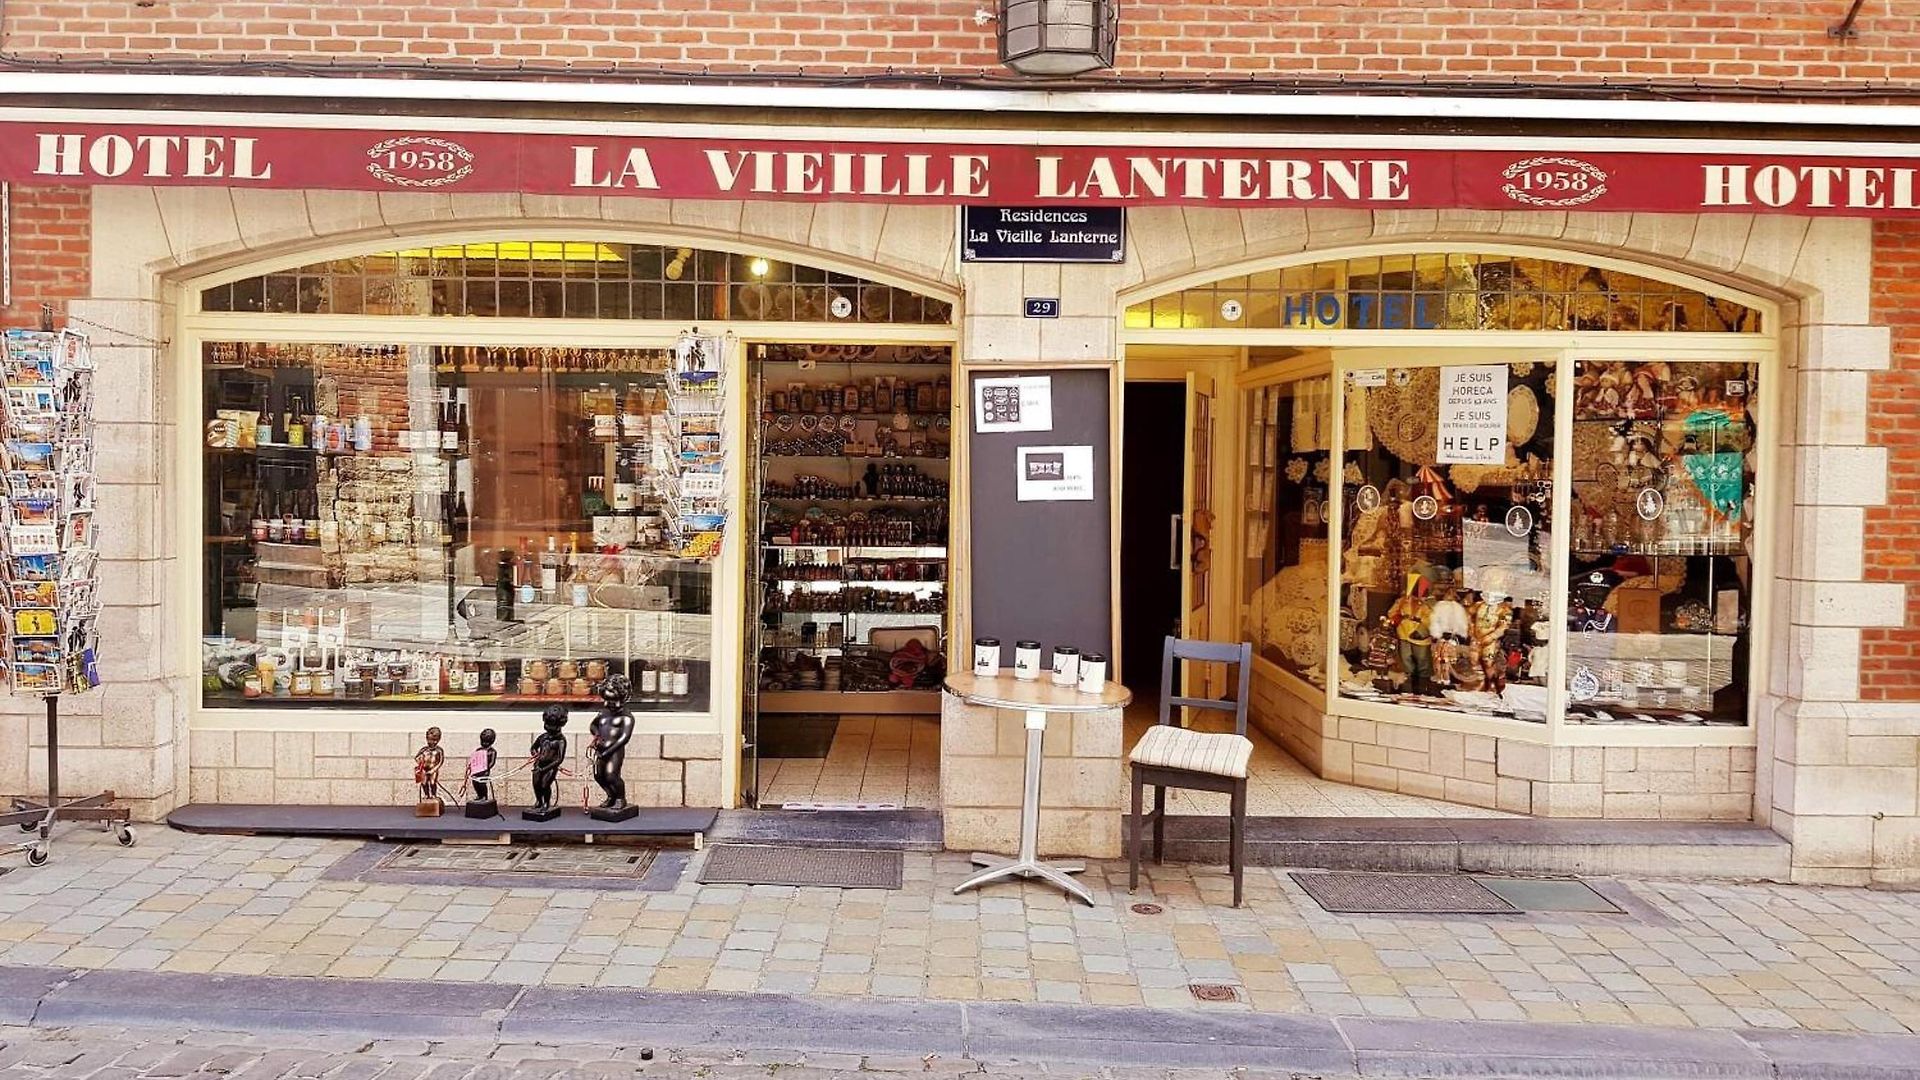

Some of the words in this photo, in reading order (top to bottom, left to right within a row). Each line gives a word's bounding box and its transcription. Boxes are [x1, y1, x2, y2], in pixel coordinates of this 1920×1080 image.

[33, 133, 271, 180] HOTEL
[384, 150, 456, 172] 1958
[570, 145, 661, 190] LA
[703, 149, 990, 197] VIEILLE
[1034, 156, 1410, 201] LANTERNE
[1520, 171, 1589, 191] 1958
[1700, 164, 1920, 210] HOTEL
[1000, 208, 1088, 223] Residences
[969, 229, 989, 242] La
[996, 229, 1043, 244] Vieille
[1049, 229, 1118, 244] Lanterne
[1032, 302, 1051, 314] 29
[1282, 292, 1437, 330] HOTEL
[1454, 373, 1466, 383] JE
[1468, 372, 1492, 383] SUIS
[1452, 386, 1493, 396] HORECA
[1453, 411, 1465, 420] JE
[1468, 411, 1491, 420] SUIS
[1443, 436, 1500, 451] HELP
